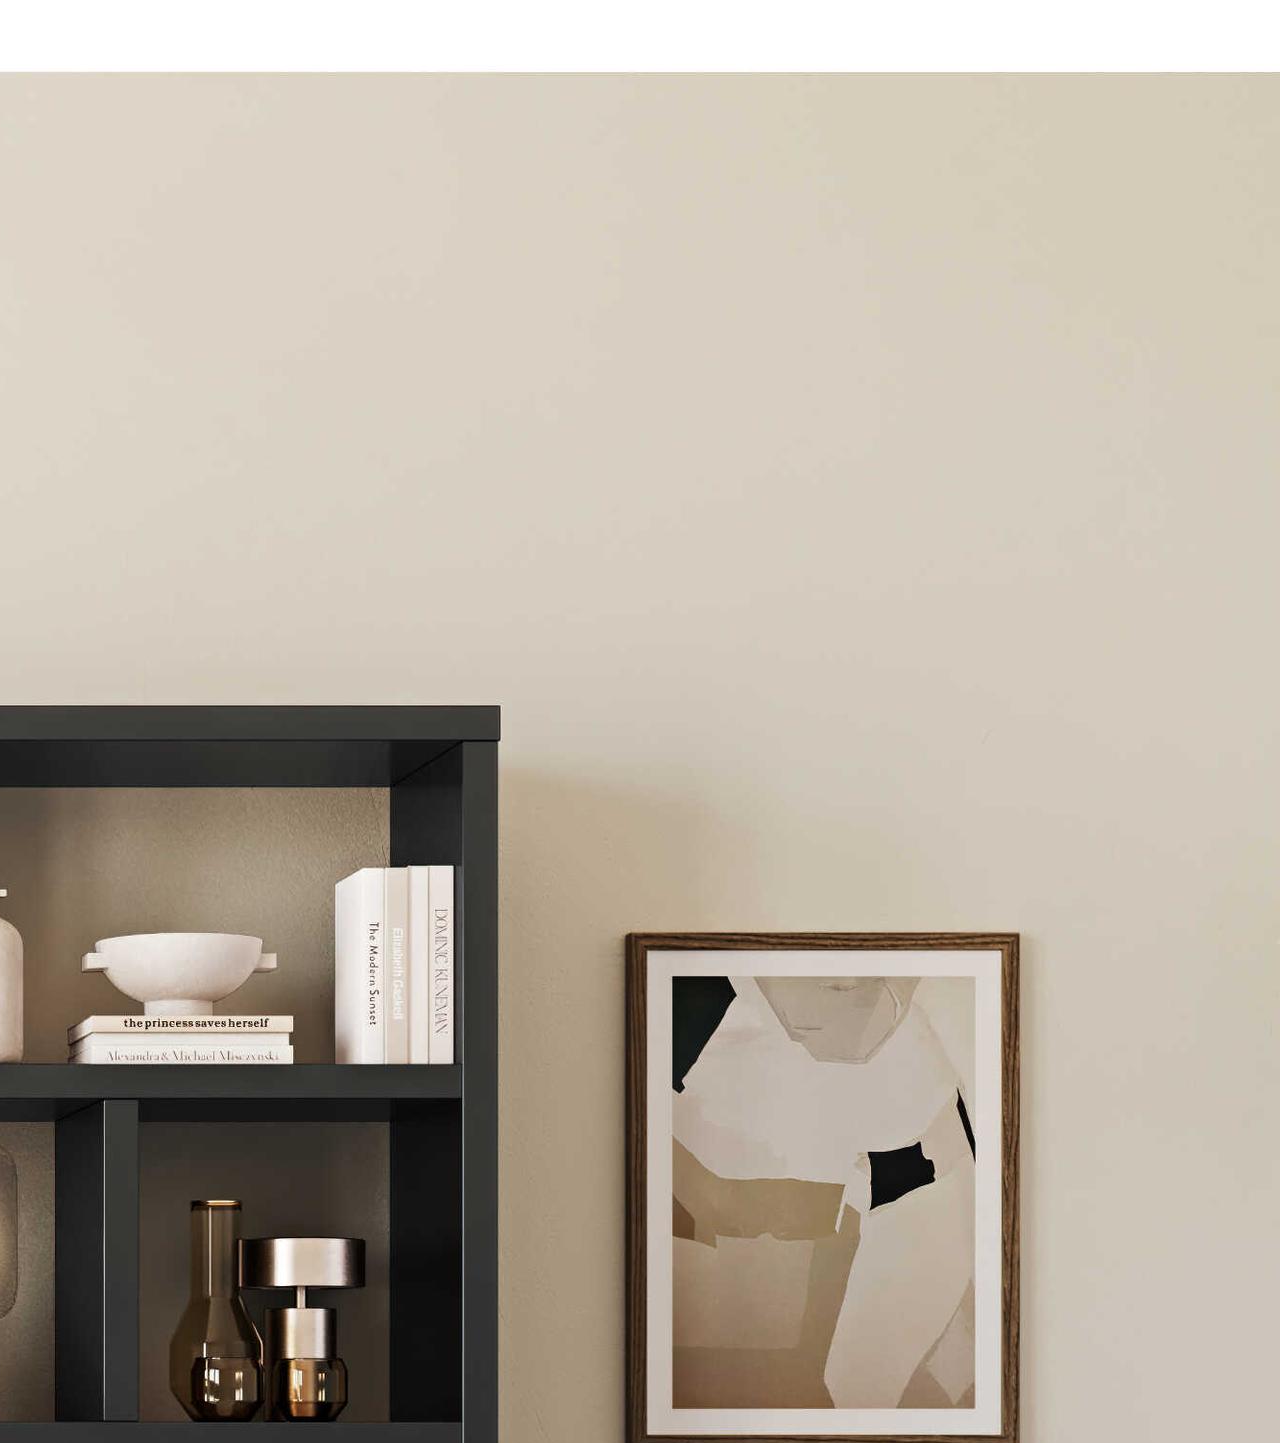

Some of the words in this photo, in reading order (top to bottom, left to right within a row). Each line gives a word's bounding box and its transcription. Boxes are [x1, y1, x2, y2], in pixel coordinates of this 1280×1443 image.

[369, 922, 380, 941] The
[434, 908, 449, 966] DOMINIC
[369, 945, 380, 986] Modern
[124, 1019, 143, 1029] the
[145, 1019, 194, 1029] princess
[195, 1019, 227, 1029] saves
[228, 1019, 270, 1029] herself
[369, 990, 380, 1026] Sunset
